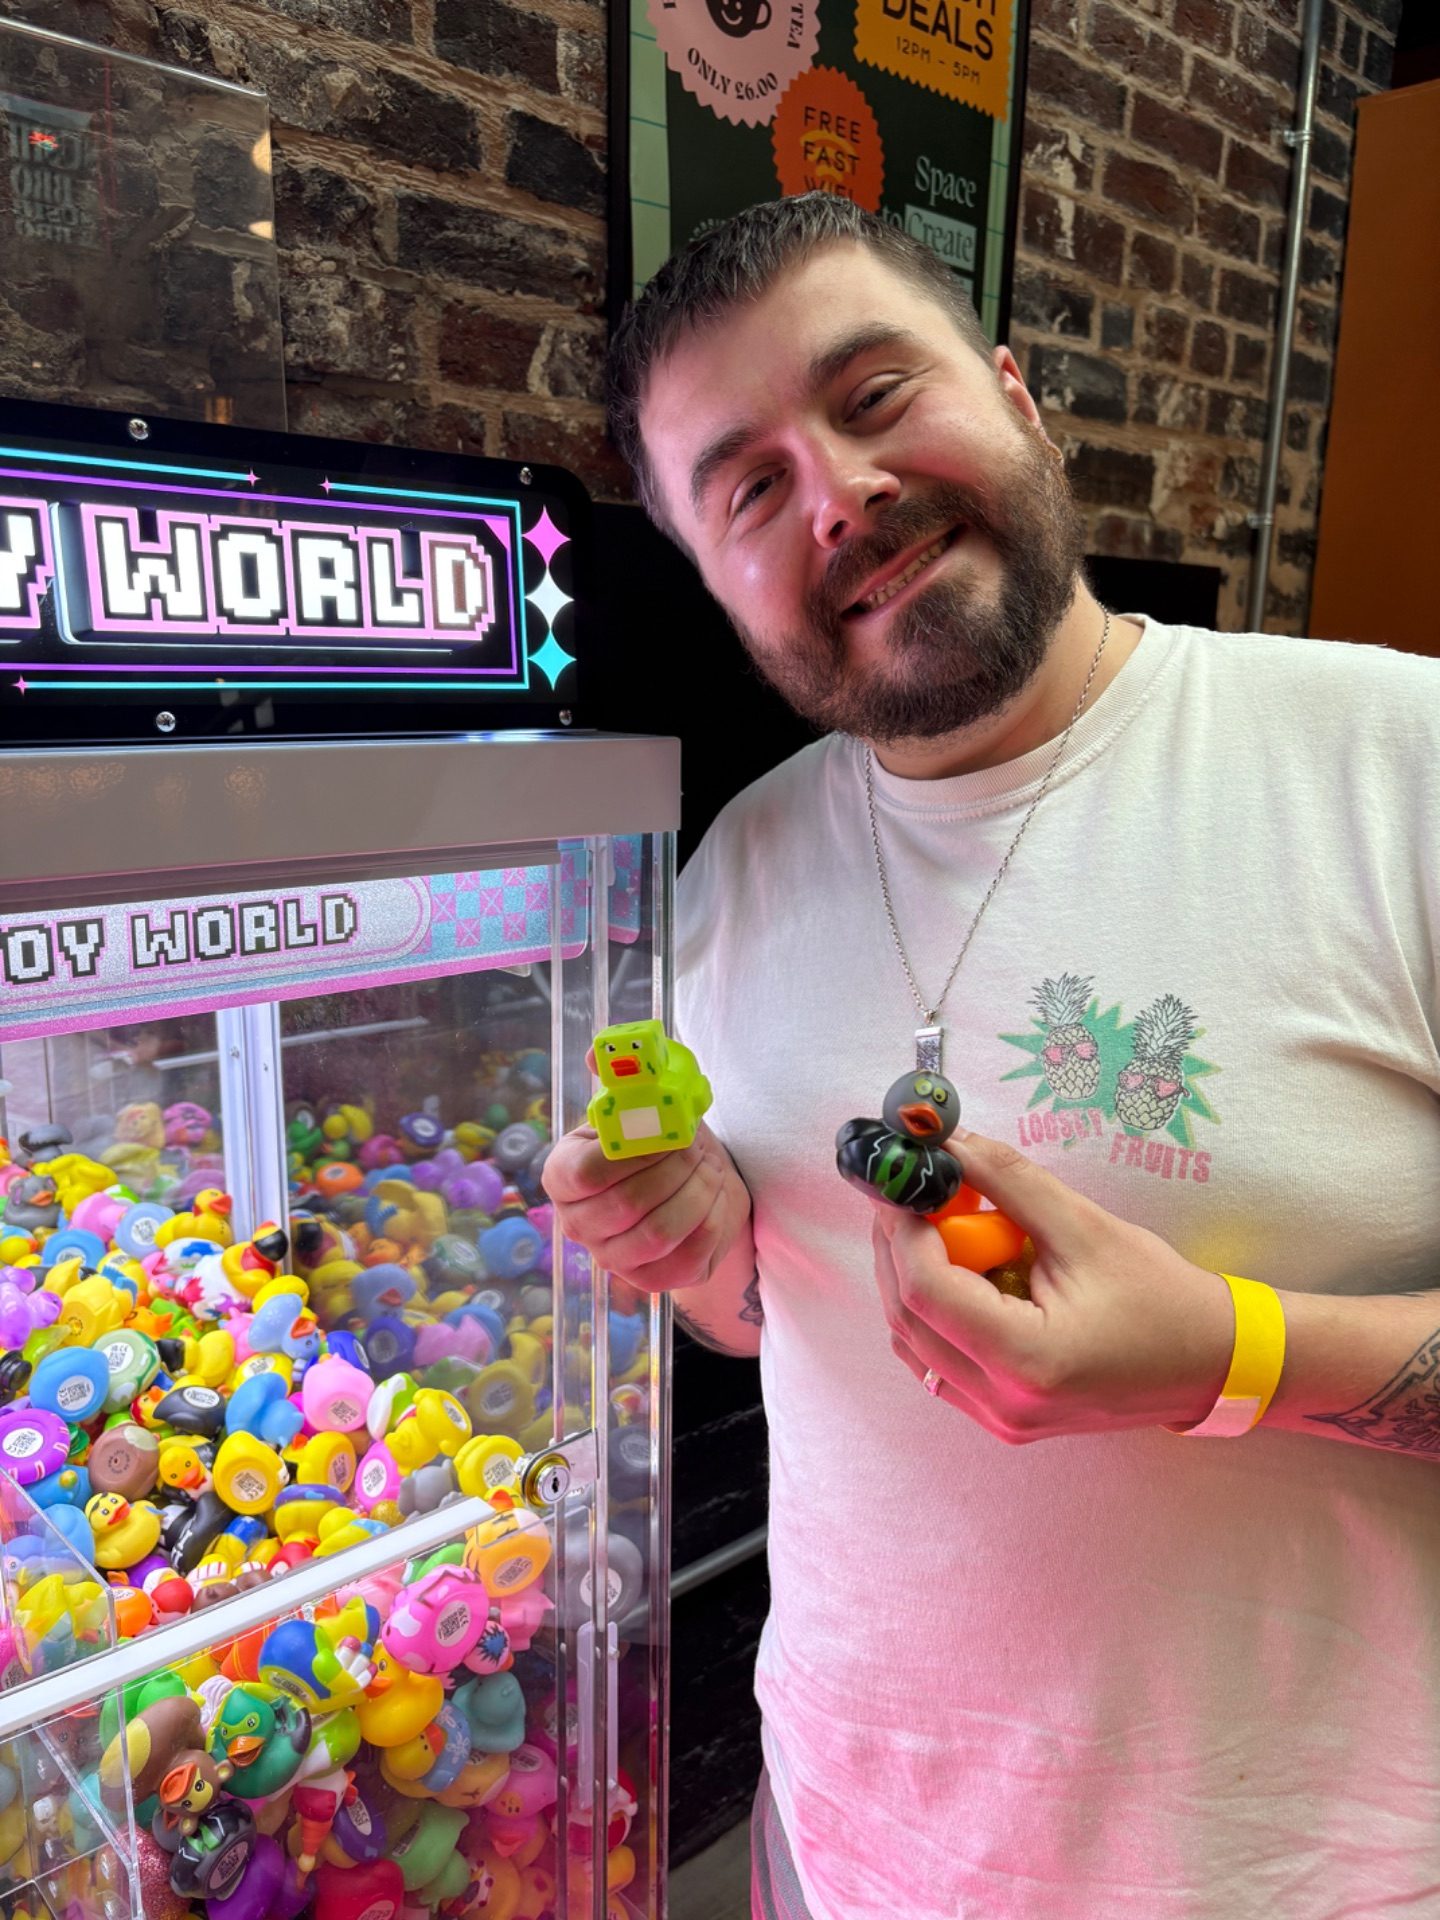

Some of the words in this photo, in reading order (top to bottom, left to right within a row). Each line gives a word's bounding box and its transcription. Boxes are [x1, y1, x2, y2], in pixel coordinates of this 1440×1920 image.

[787, 2, 804, 49] TEA
[687, 47, 732, 95] ONLY
[734, 72, 779, 101] £6.00
[896, 36, 931, 64] 12PM
[952, 61, 981, 85] 5PM
[804, 105, 862, 144] FREE
[803, 141, 860, 176] FAST
[915, 155, 977, 208] Space
[907, 212, 973, 263] Create
[88, 510, 490, 636] WORLD
[131, 892, 357, 969] WORLD
[1109, 1132, 1212, 1184] FRUITS
